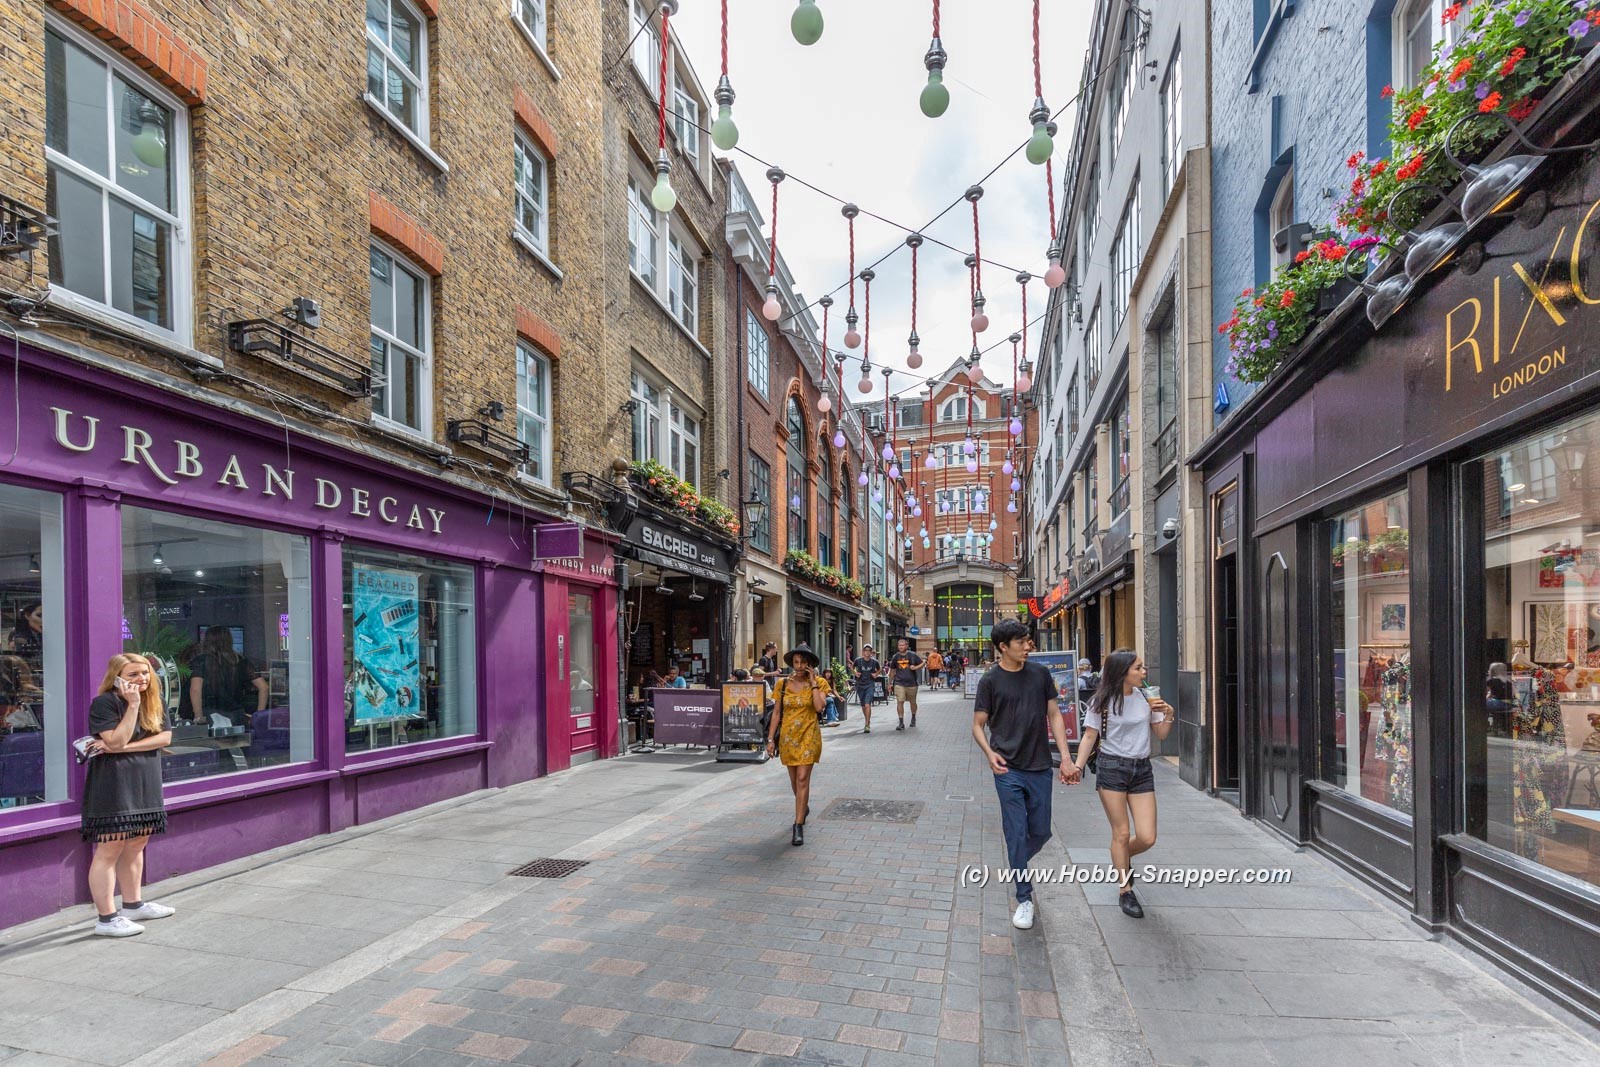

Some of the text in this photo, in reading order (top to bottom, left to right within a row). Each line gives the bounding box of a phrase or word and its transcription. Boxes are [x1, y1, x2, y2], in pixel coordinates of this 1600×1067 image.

[1492, 346, 1567, 399] LONDON
[50, 406, 446, 534] URBAN DECAY
[642, 526, 716, 566] SACRED CAFÉ
[1018, 584, 1032, 592] PIX
